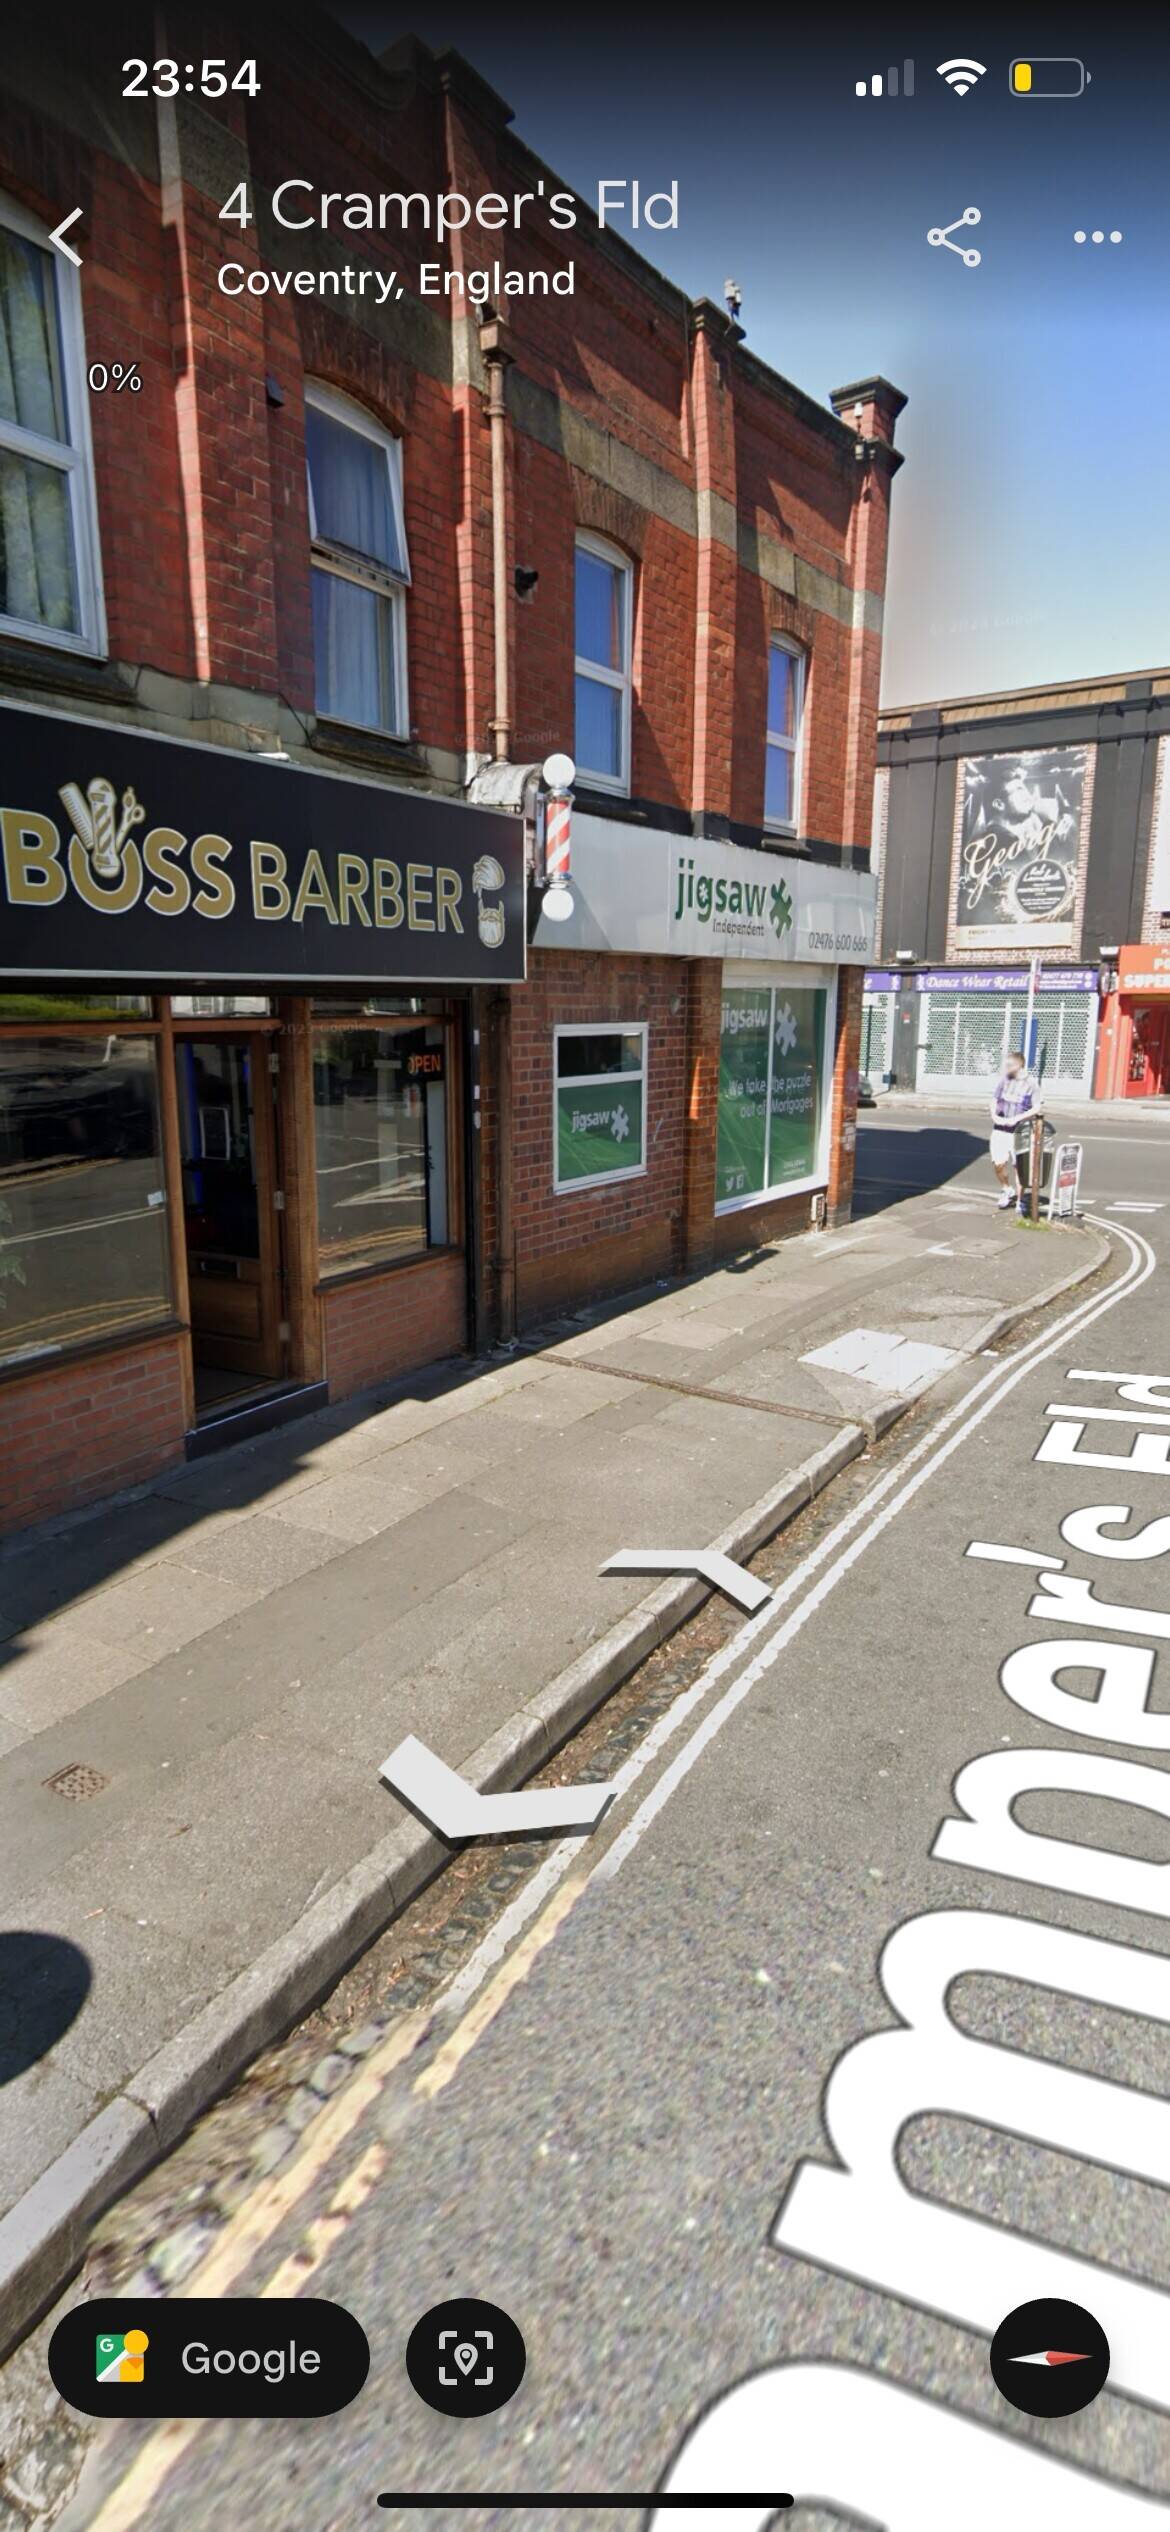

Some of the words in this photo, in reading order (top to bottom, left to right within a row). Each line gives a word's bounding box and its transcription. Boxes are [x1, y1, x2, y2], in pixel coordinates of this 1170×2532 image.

[0, 808, 236, 920] BOSS
[249, 840, 465, 935] BARBER
[674, 857, 767, 923] jigsaw
[712, 918, 765, 938] Independent
[926, 976, 959, 988] Dance
[963, 974, 992, 988] Wear
[993, 974, 1029, 991] Retail
[571, 1111, 609, 1133] jigsaw
